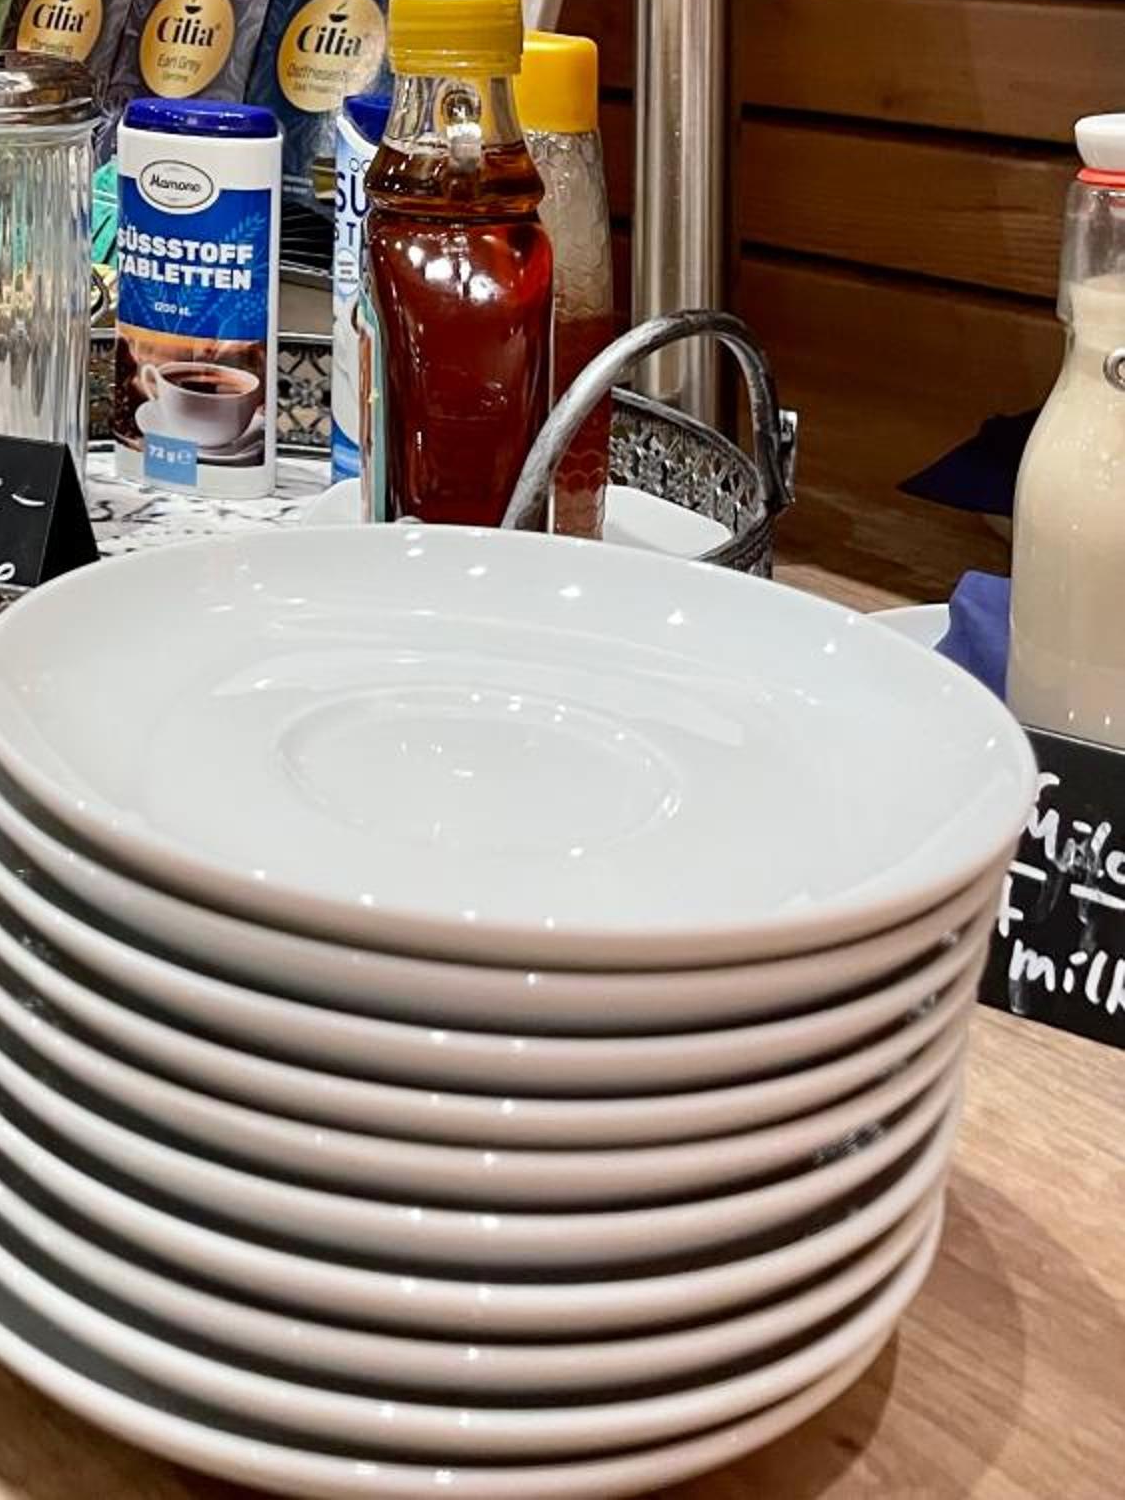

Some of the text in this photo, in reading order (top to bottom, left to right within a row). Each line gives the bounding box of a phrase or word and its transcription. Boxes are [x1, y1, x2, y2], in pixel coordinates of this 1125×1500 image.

[32, 3, 85, 32] Cilia
[157, 16, 215, 47] Cilia
[296, 24, 362, 56] Cilia
[157, 53, 177, 68] Earl
[116, 225, 254, 264] SÜSSSTOFF
[117, 252, 252, 291] TABLETTEN
